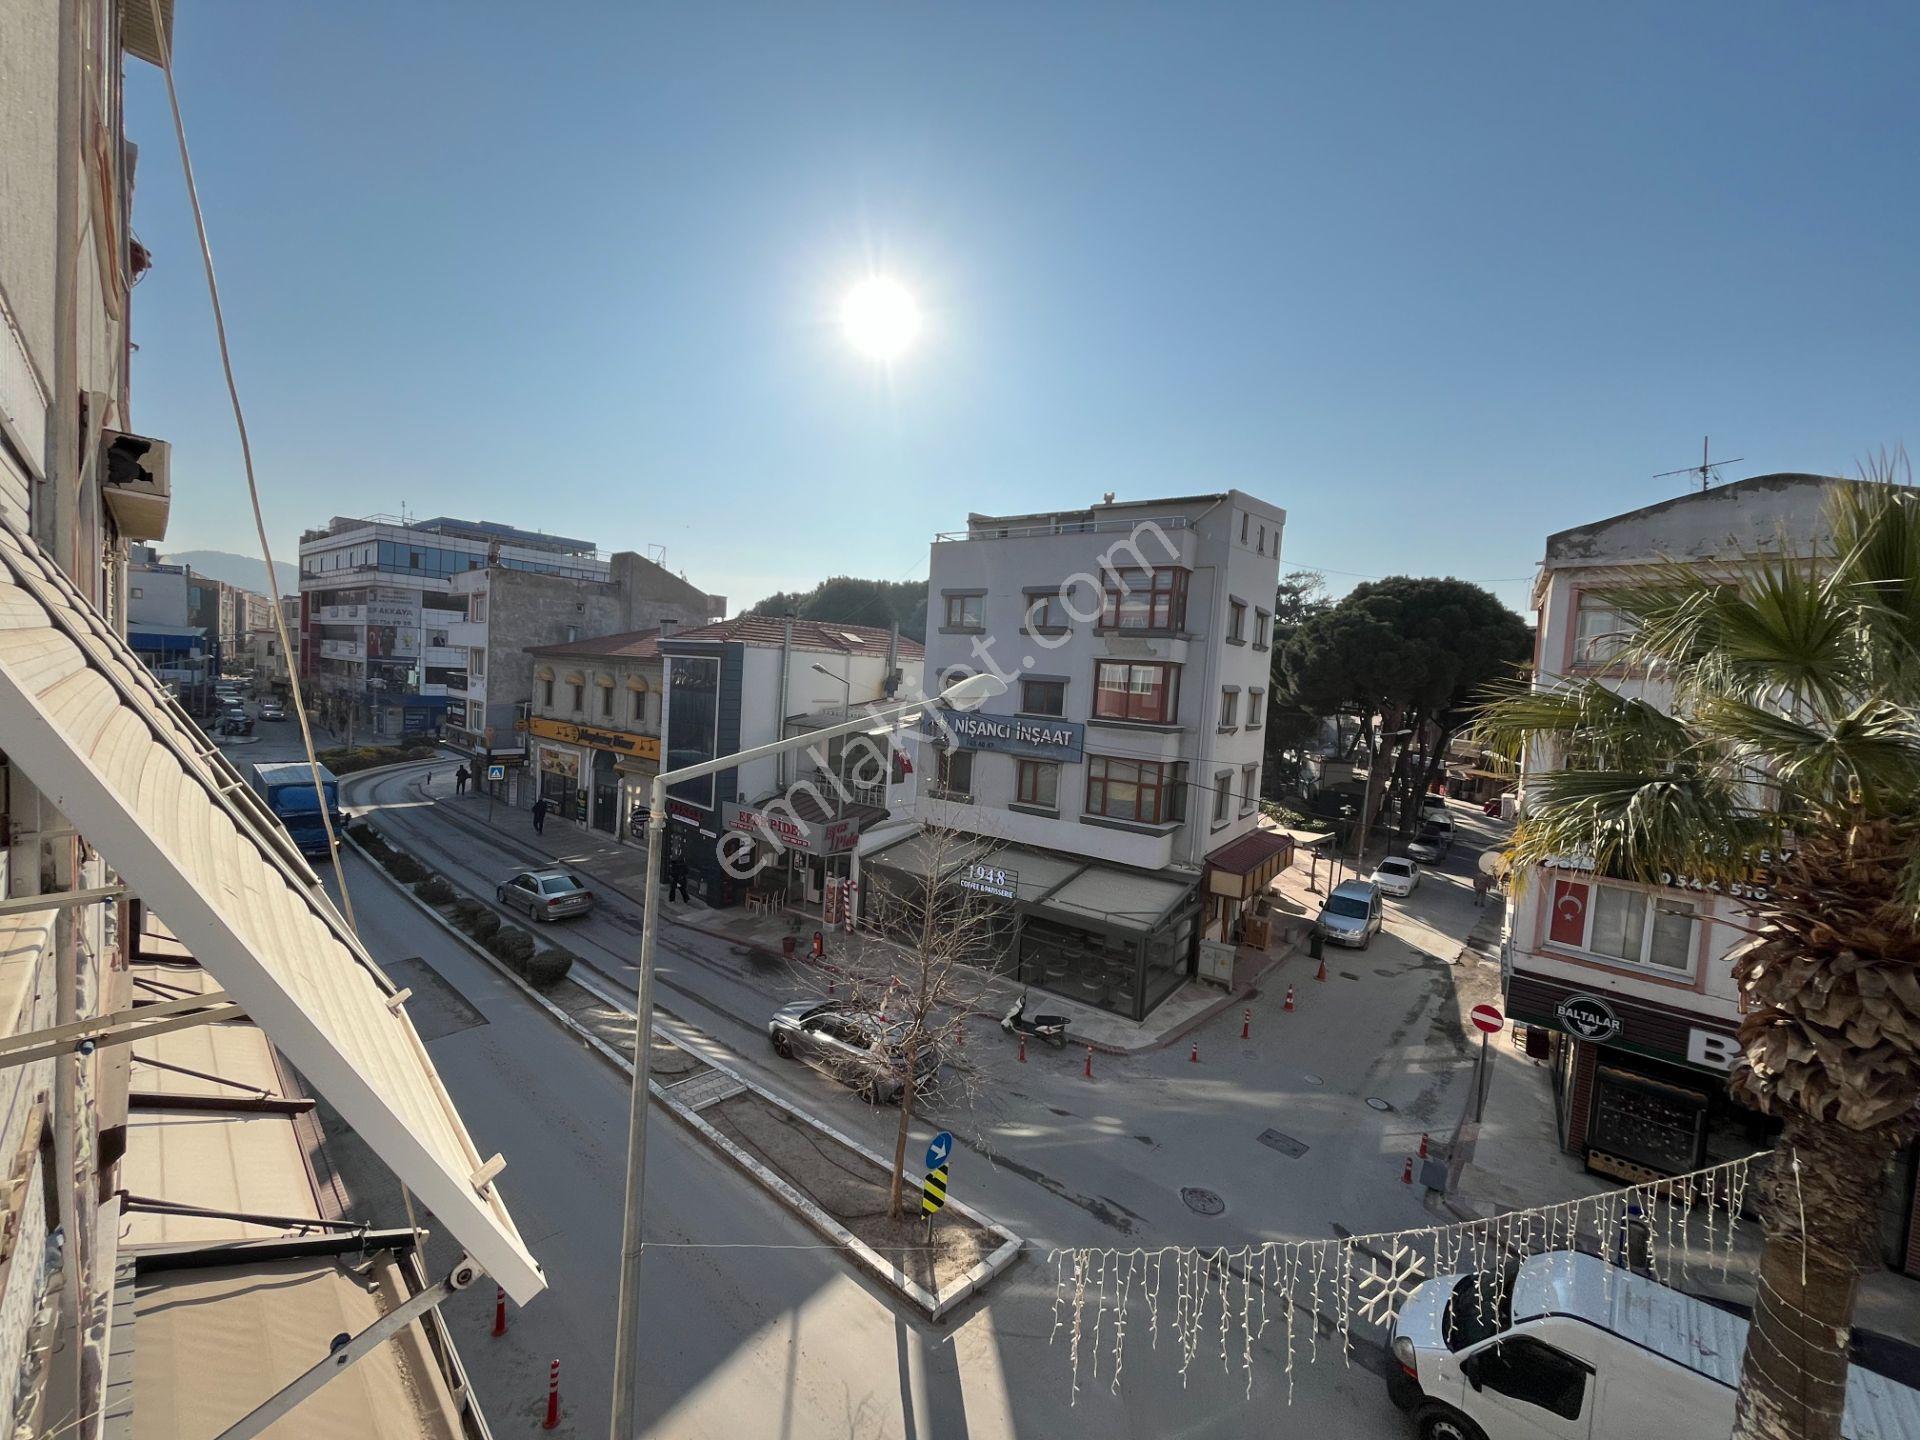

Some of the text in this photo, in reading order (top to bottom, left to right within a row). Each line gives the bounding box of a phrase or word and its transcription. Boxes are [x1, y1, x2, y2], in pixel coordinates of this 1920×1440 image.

[1016, 722, 1073, 746] İNŞAAT
[770, 817, 799, 836] PİDE
[969, 865, 1006, 886] 1948
[960, 880, 980, 891] COFFEE
[984, 885, 1014, 899] PATISSERIE
[1557, 1005, 1621, 1030] BALTALAR
